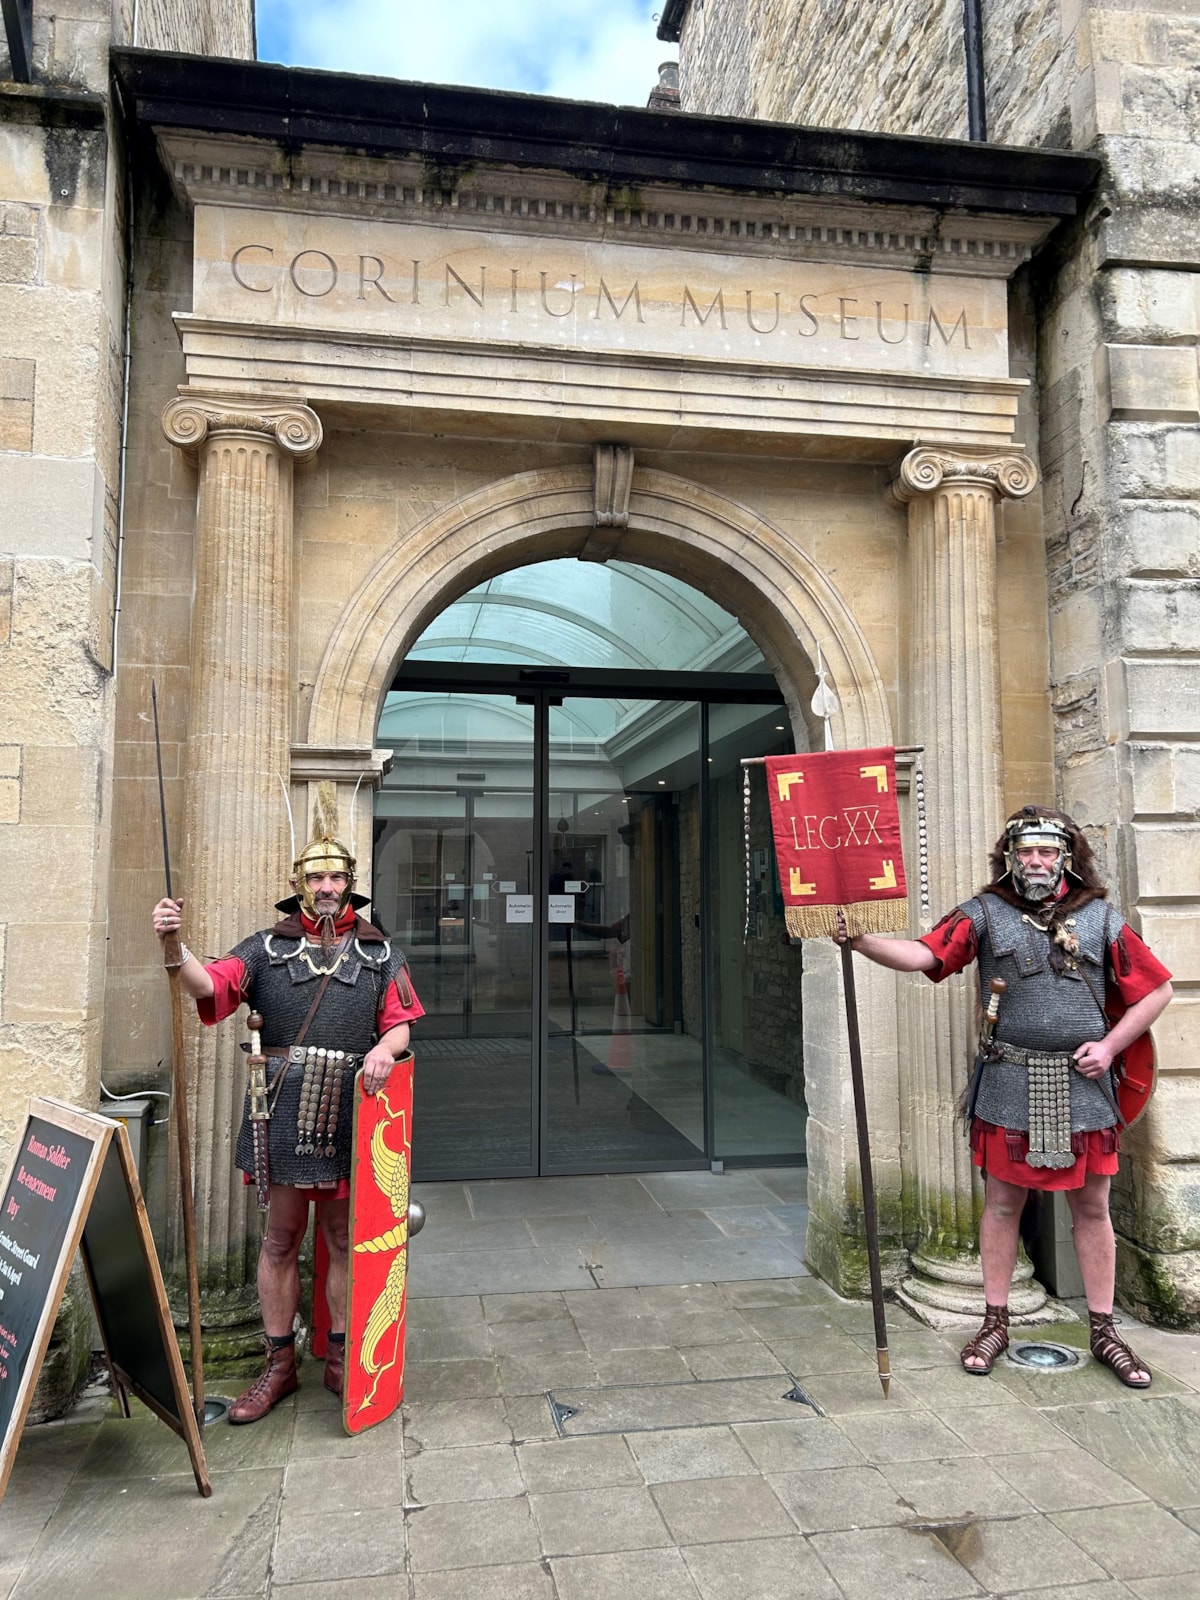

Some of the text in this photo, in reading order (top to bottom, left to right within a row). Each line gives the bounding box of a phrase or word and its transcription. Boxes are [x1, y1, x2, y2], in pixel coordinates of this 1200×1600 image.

[230, 244, 972, 350] CORINIUM MUSEUM
[27, 1134, 71, 1169] Roman Soldier
[7, 1196, 20, 1221] Day
